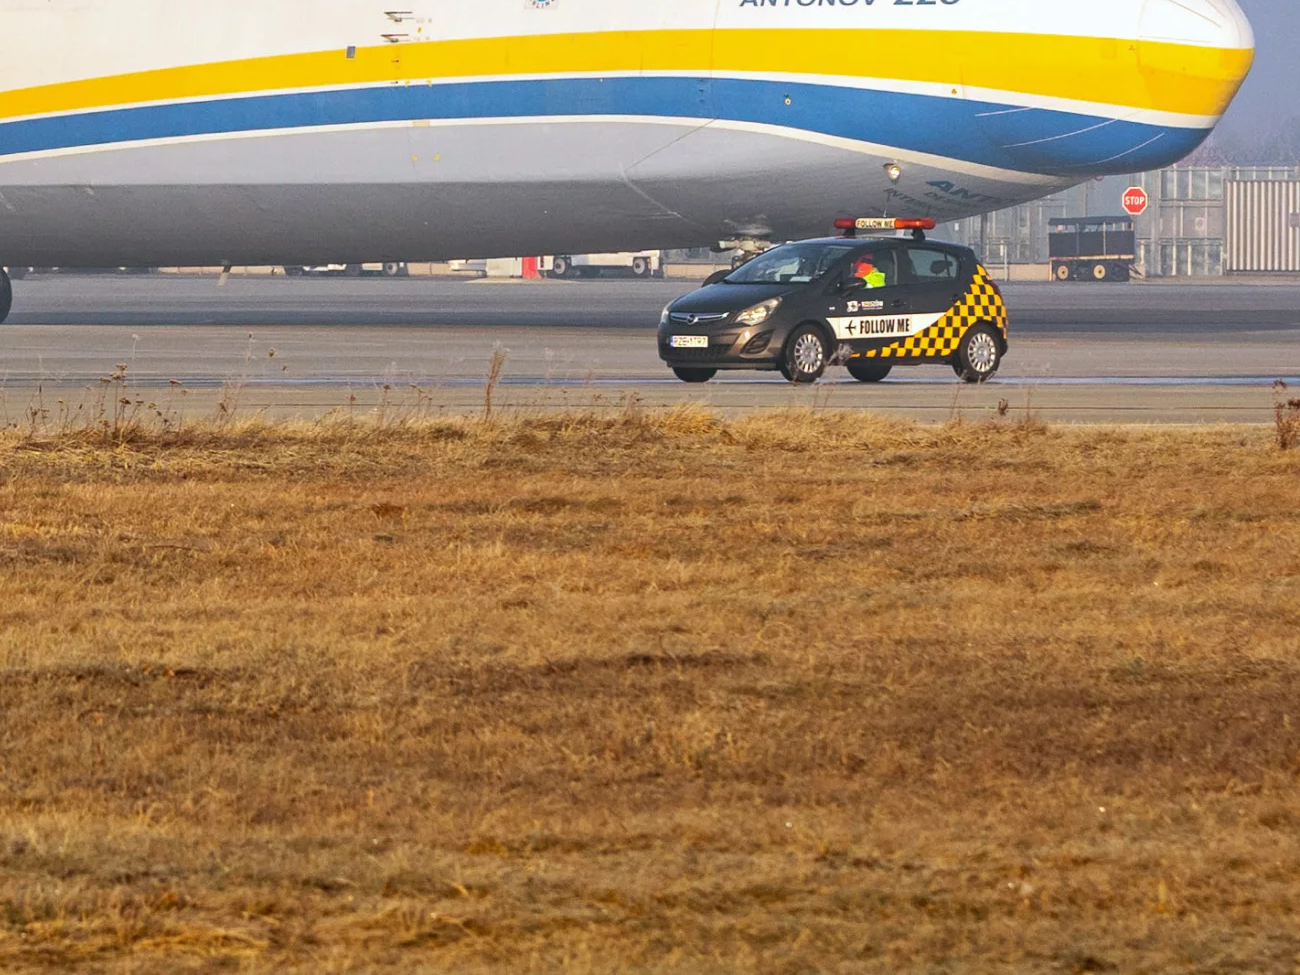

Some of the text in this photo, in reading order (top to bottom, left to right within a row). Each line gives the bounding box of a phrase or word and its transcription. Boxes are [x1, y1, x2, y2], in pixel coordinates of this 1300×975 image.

[1125, 196, 1146, 206] STOP
[856, 220, 894, 229] FOLLOW ME
[859, 318, 910, 334] FOLLOW ME
